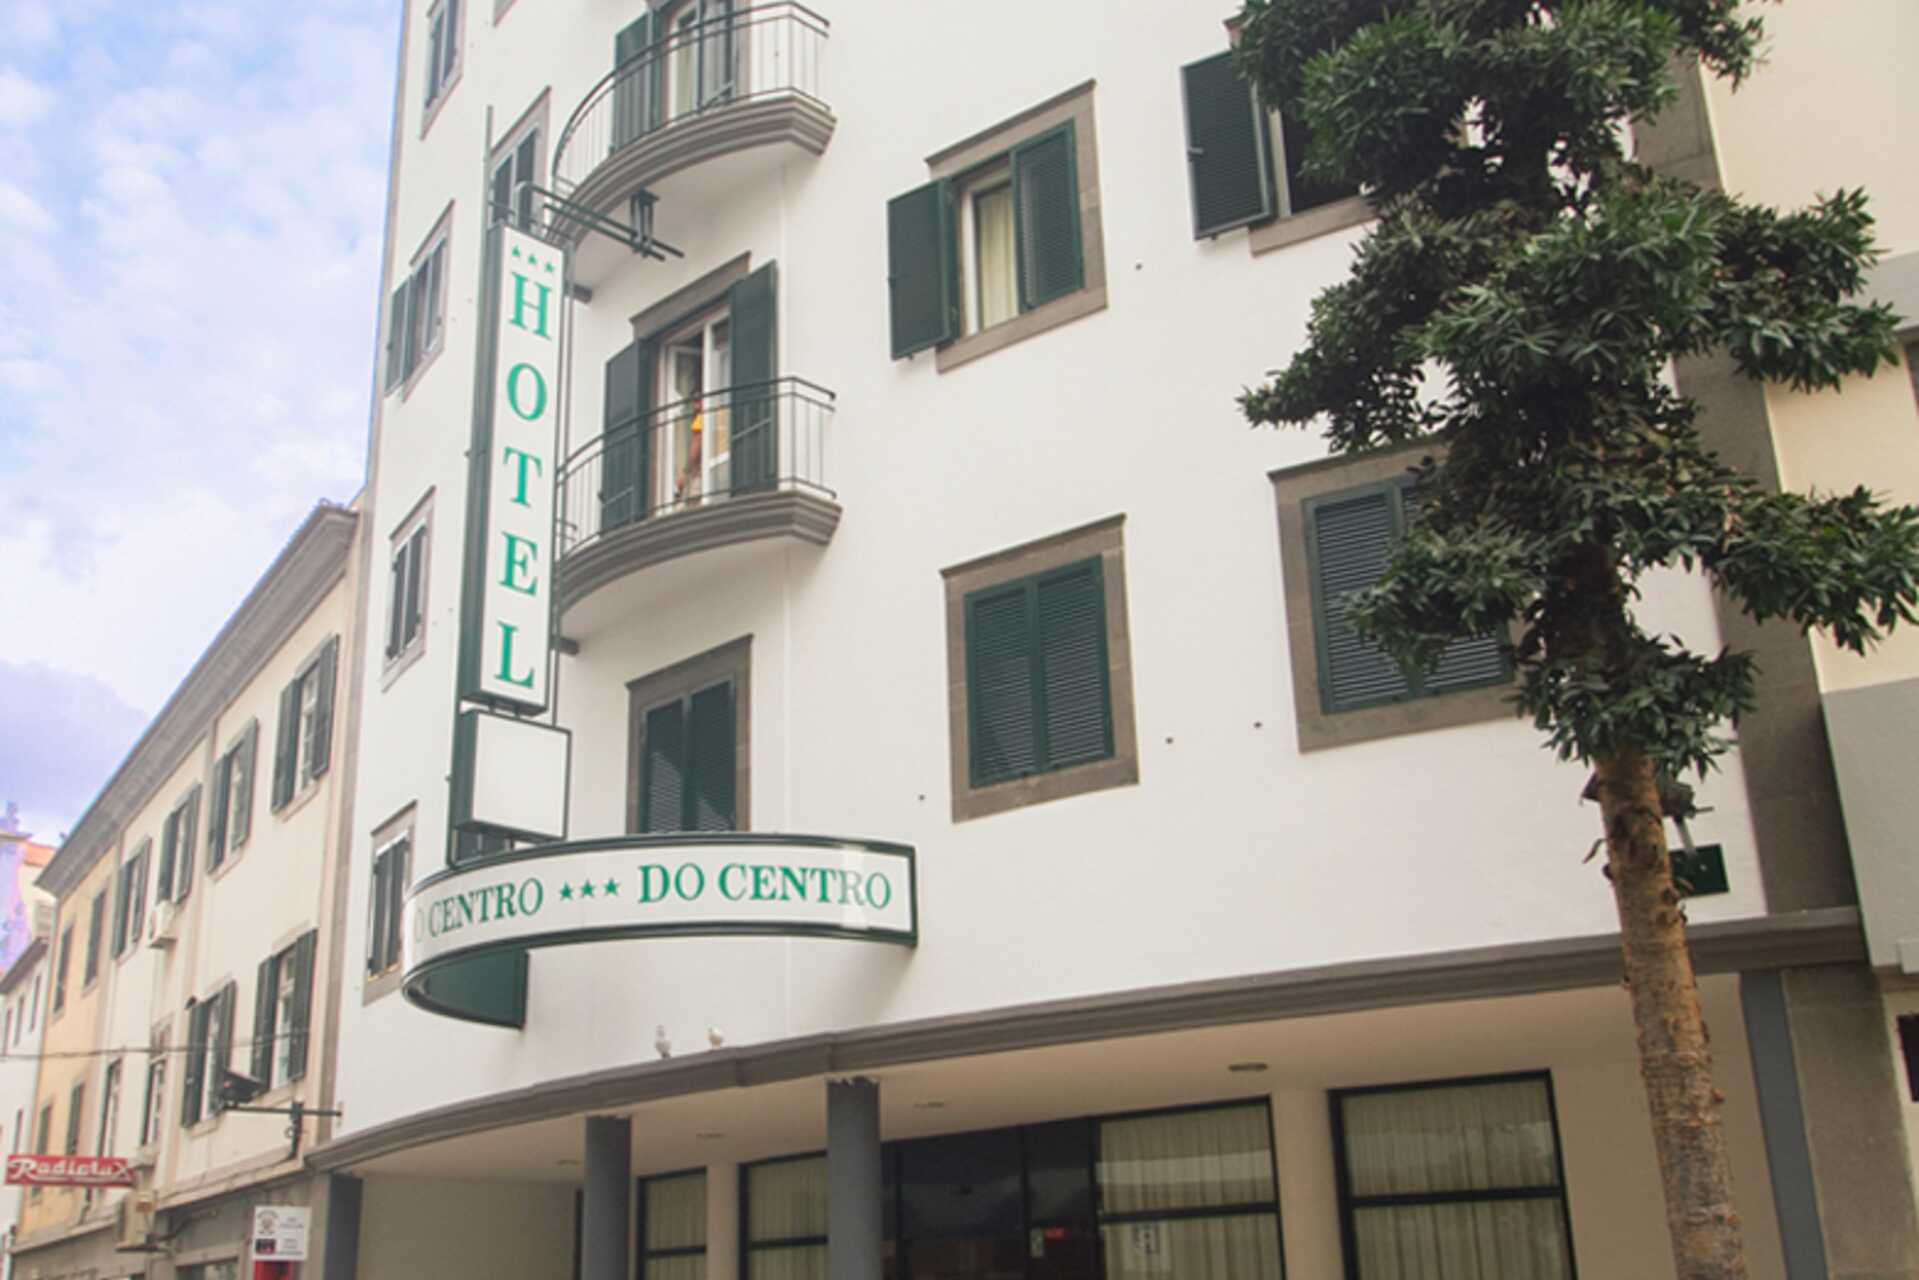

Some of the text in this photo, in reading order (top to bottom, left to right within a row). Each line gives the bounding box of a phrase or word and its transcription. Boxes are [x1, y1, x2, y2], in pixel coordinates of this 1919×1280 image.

[494, 270, 552, 690] HOTEL
[428, 877, 544, 937] CENTRO
[638, 863, 705, 904] DO
[718, 863, 892, 909] CENTRO
